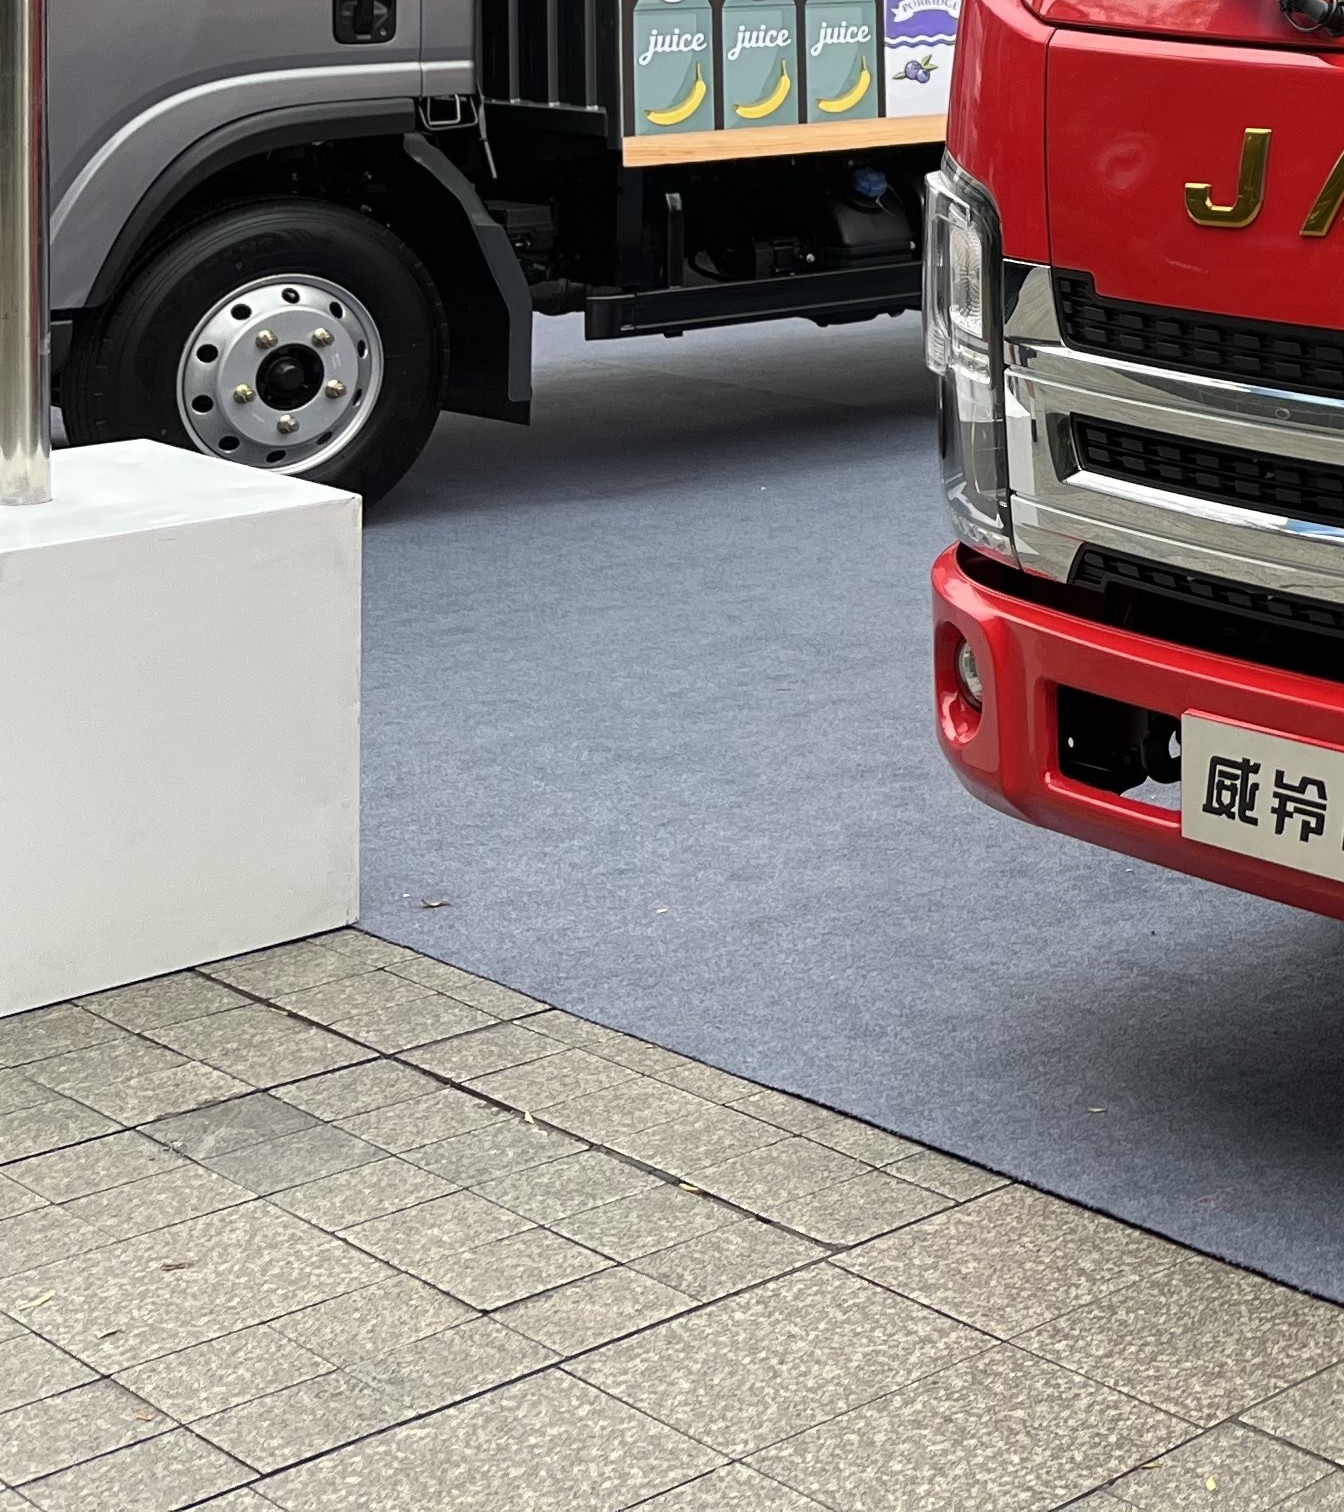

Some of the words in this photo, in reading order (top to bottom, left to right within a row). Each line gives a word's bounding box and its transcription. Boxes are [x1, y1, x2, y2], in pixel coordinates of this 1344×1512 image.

[638, 28, 708, 66] juice
[727, 23, 792, 62] juice
[810, 20, 872, 58] juice
